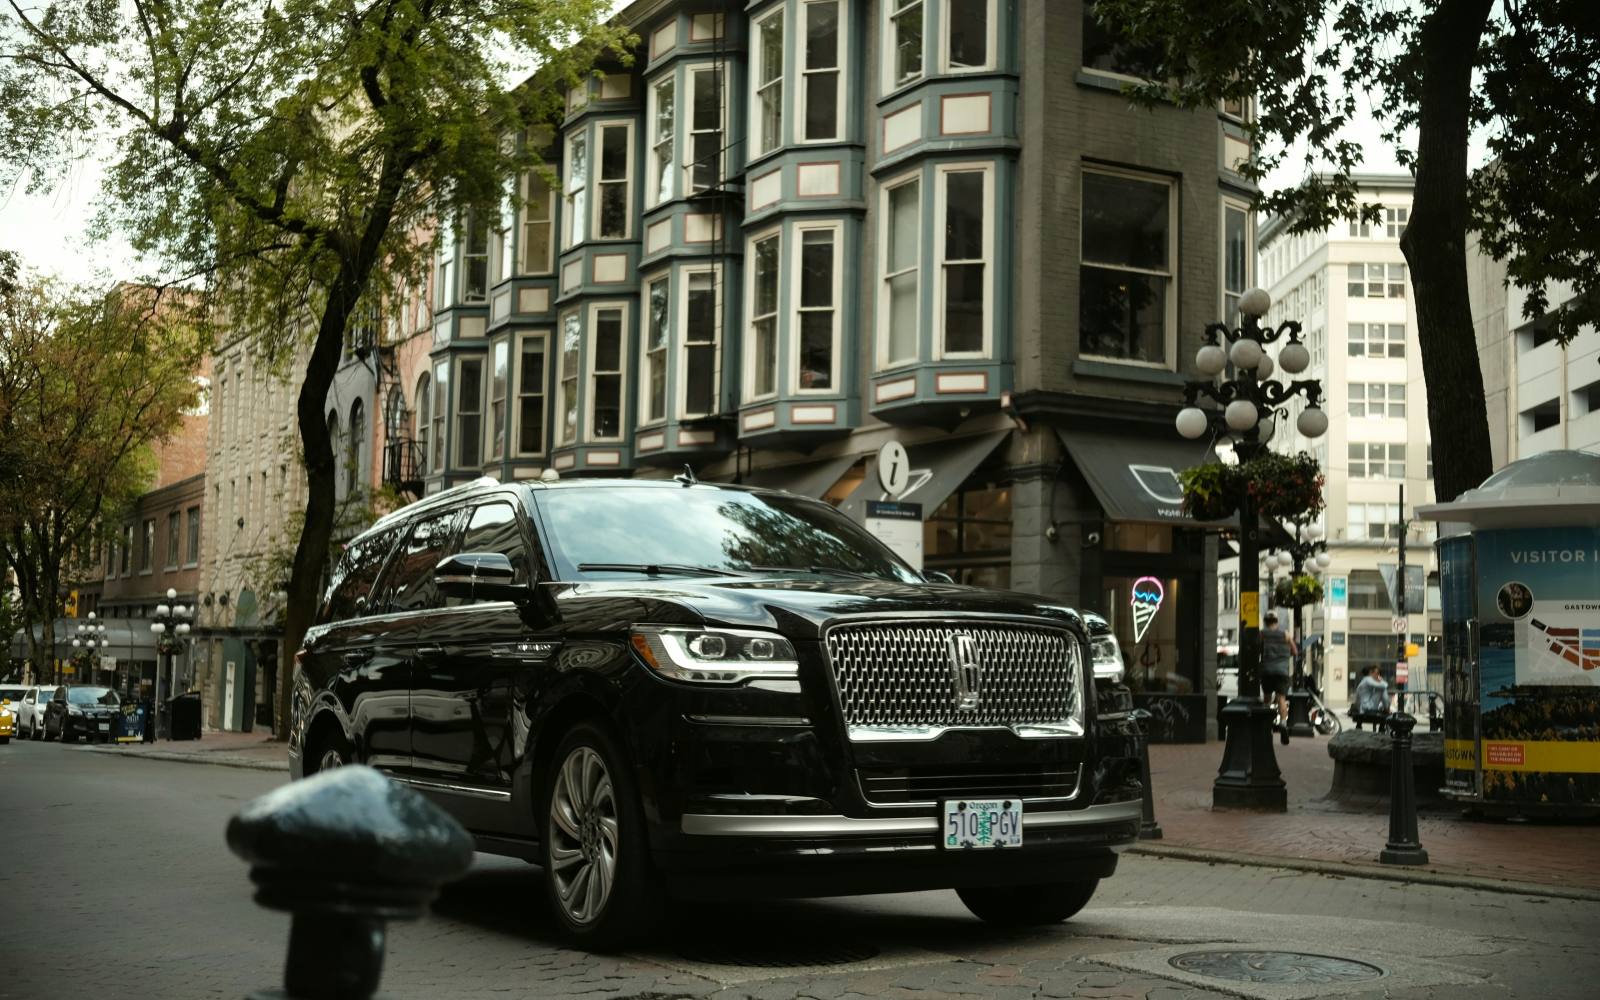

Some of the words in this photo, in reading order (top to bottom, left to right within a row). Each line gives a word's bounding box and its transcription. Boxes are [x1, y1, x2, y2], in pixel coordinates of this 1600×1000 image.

[1510, 550, 1585, 564] VISITOR
[969, 801, 998, 810] Oregon
[949, 812, 978, 836] 510
[990, 811, 1019, 836] PGV
